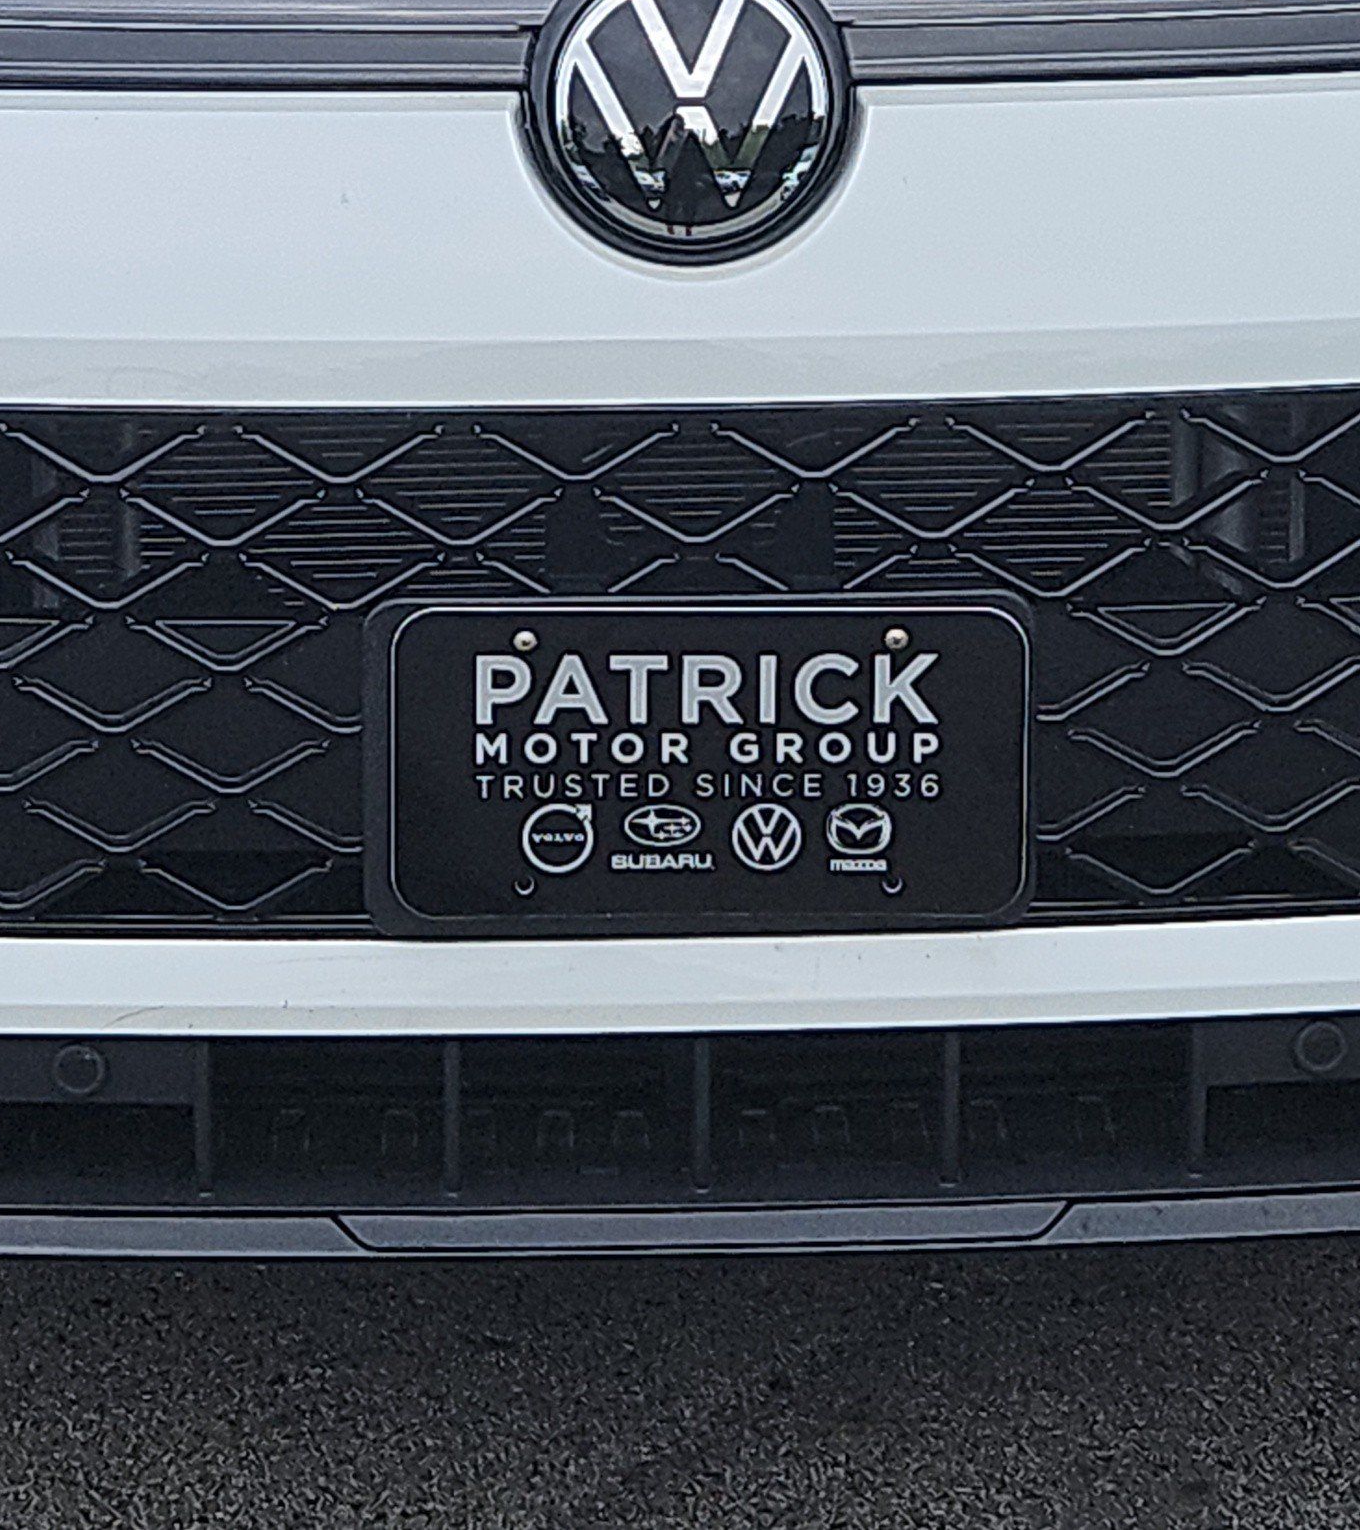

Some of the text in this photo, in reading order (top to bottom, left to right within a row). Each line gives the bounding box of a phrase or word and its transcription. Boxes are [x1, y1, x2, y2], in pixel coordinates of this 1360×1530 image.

[474, 653, 939, 726] PATRICK
[476, 731, 940, 765] MOTOR GROUP
[477, 772, 941, 800] TRUSTED SINCE 1936
[531, 832, 585, 843] VOLVO
[611, 853, 712, 870] SUBARU
[829, 858, 888, 872] mazda
